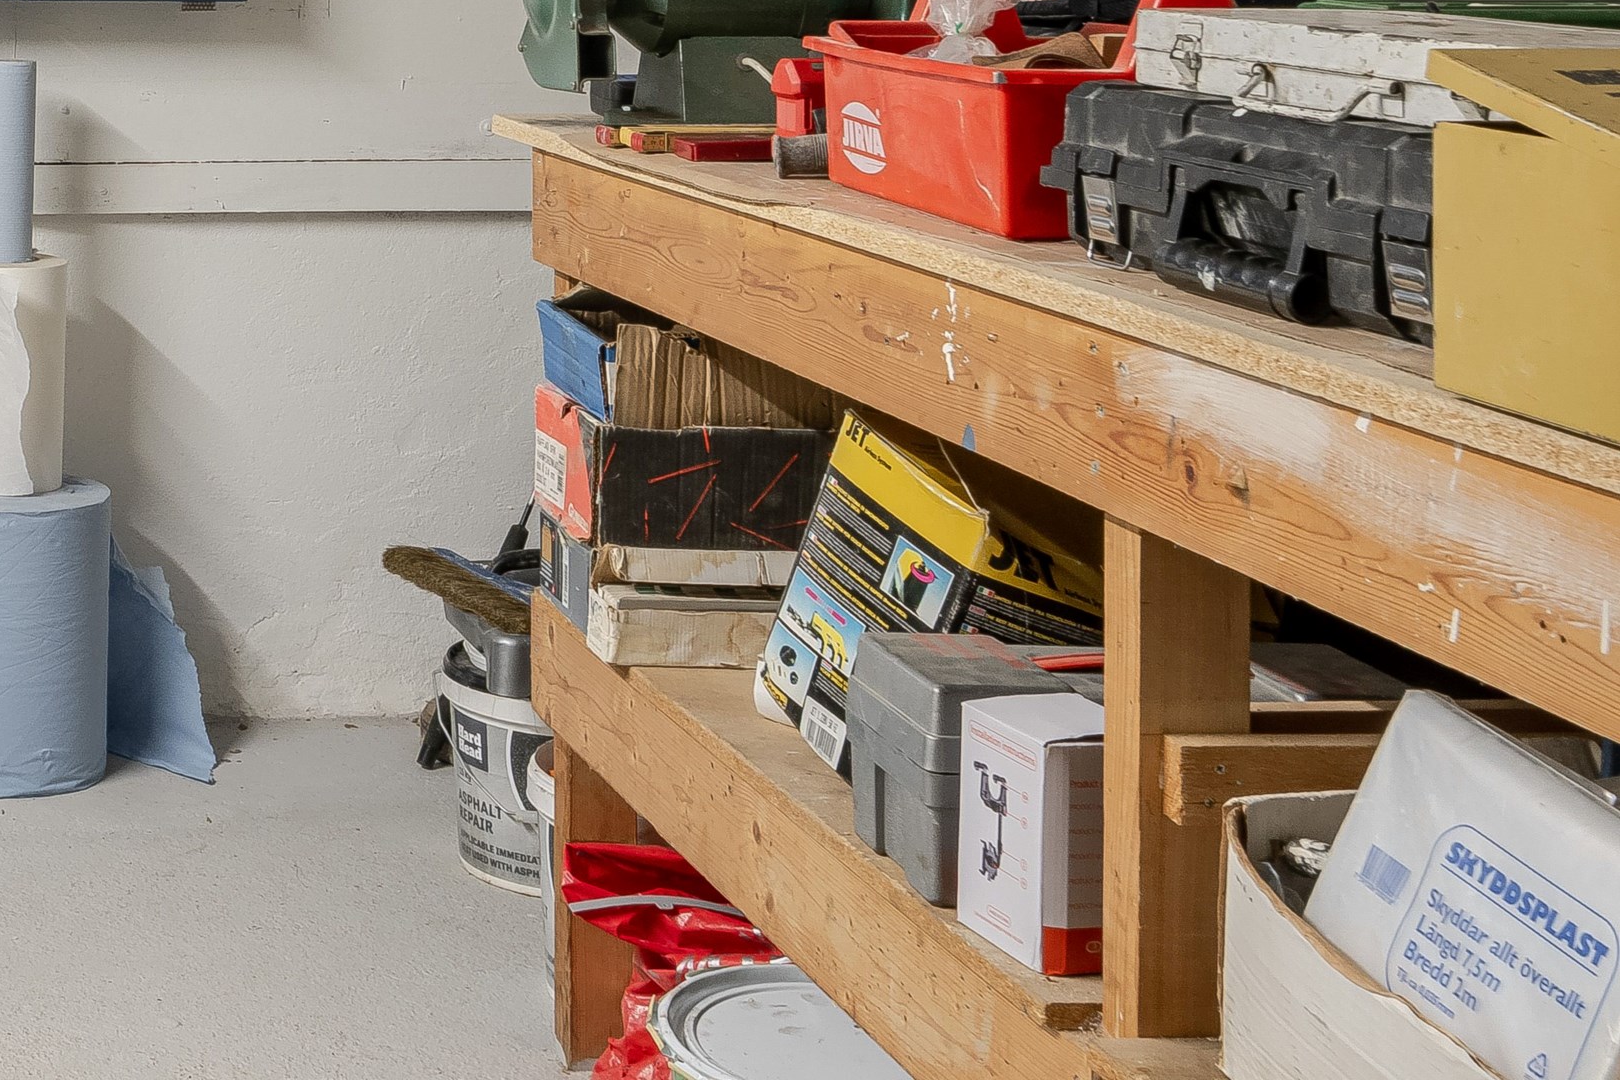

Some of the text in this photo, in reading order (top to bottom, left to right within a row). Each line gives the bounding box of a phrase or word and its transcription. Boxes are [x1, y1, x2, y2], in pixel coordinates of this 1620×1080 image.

[842, 117, 887, 159] JIRVA
[845, 418, 871, 448] JET
[987, 527, 1058, 592] JET
[457, 722, 482, 747] Hard
[458, 736, 483, 762] Head
[458, 787, 502, 820] ASPHALT
[459, 804, 494, 835] REPAIR
[489, 857, 513, 874] WITH
[1445, 841, 1610, 967] SKYDDSPLAST
[1415, 913, 1461, 962] Längd
[1426, 887, 1586, 1020] Skyddar allt överallt
[1403, 939, 1454, 989] Bredd
